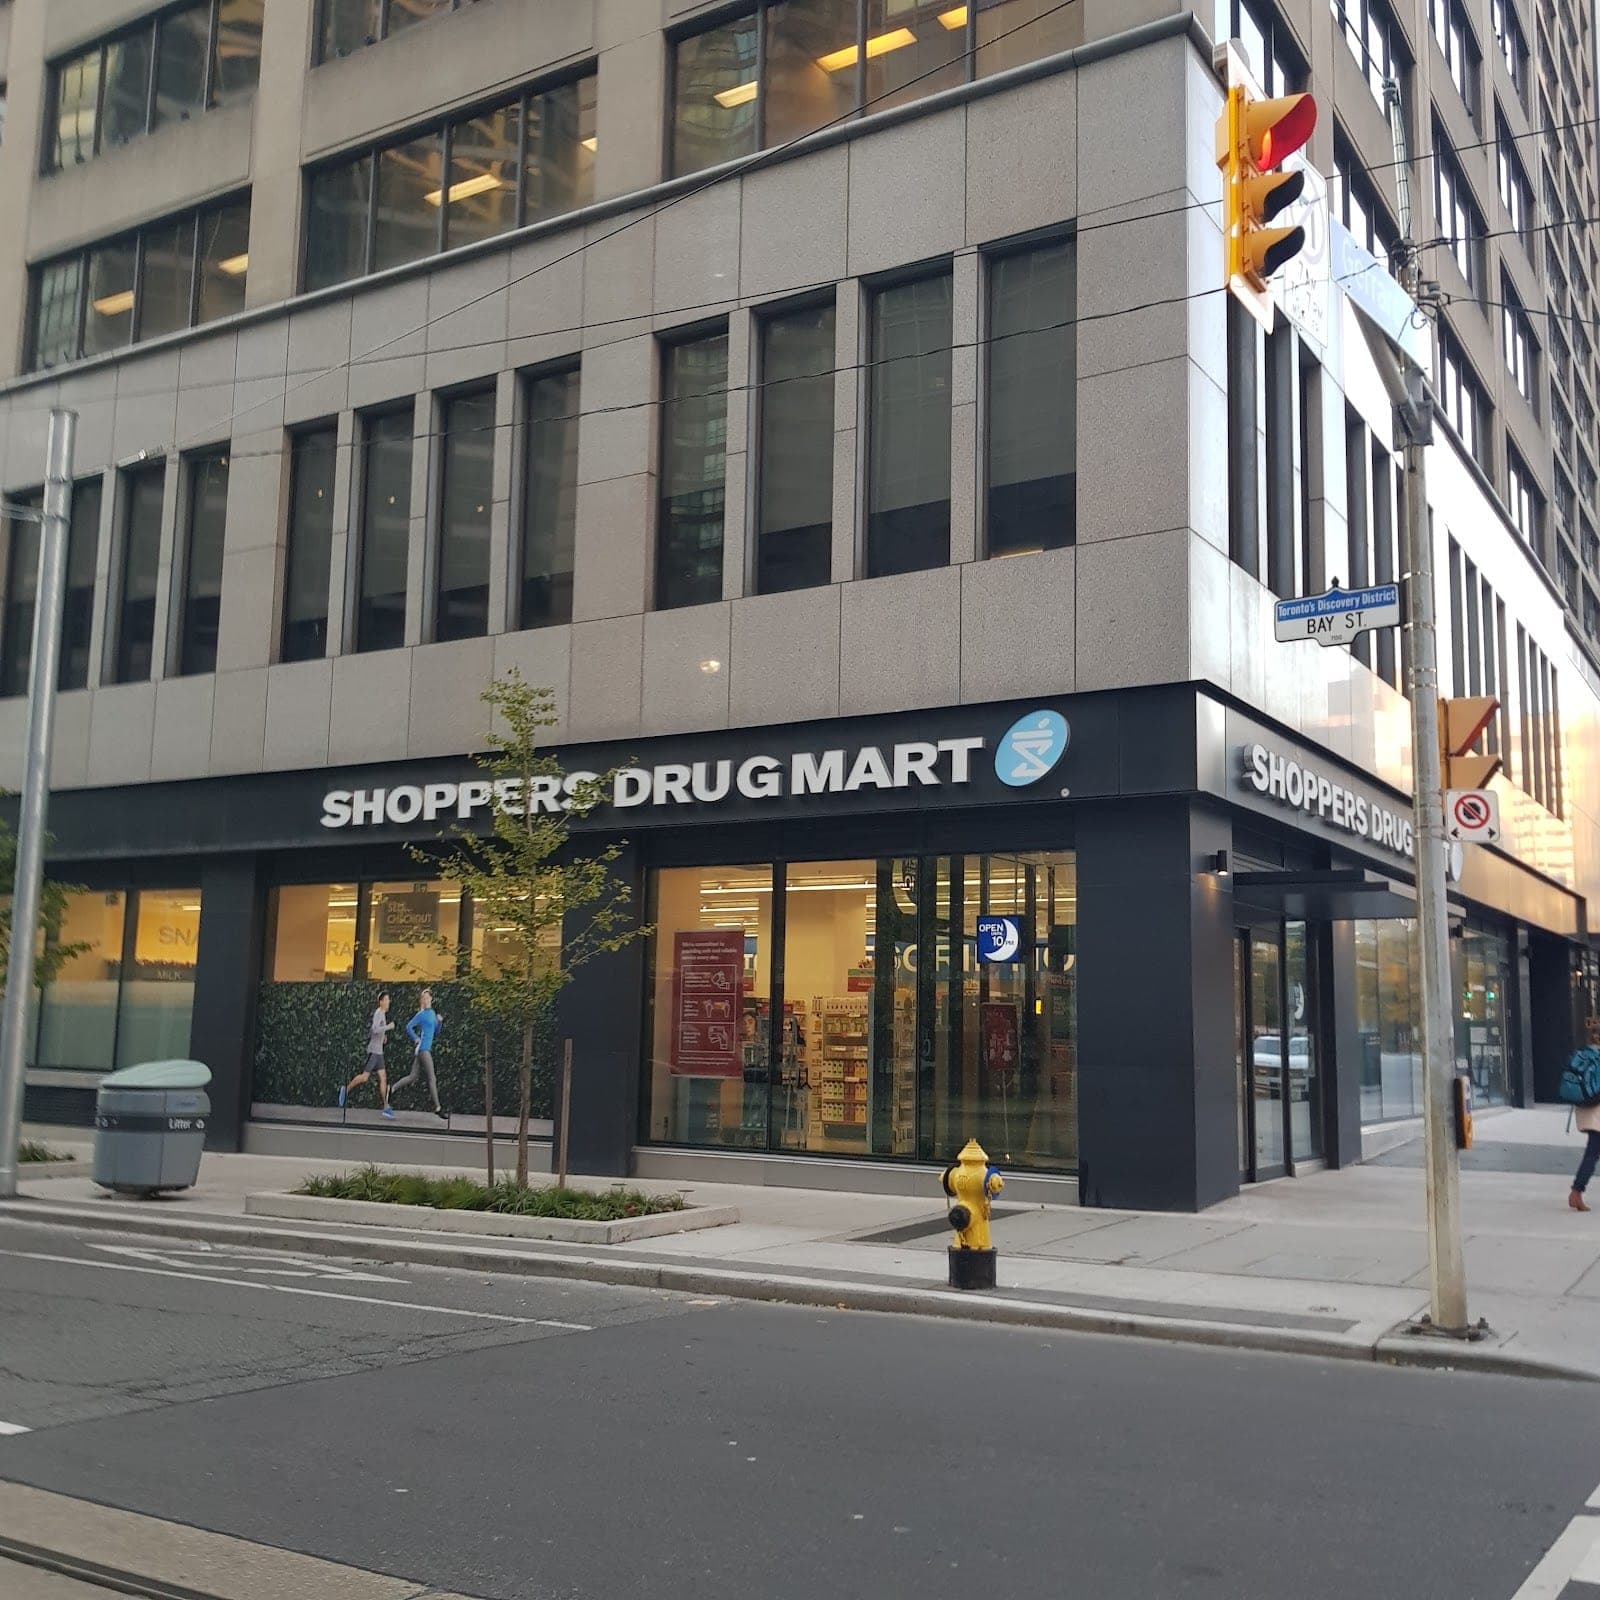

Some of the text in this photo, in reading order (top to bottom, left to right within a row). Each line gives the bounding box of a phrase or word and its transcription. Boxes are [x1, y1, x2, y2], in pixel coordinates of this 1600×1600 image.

[1279, 590, 1395, 617] Toronto's Discovery District
[1307, 616, 1335, 634] BAY
[613, 755, 782, 808] DRUG
[790, 736, 984, 796] MART
[1248, 744, 1413, 857] SHOPPERS DRUG
[979, 923, 1004, 932] OPEN
[991, 936, 1004, 946] 10
[168, 1118, 191, 1129] Litter
